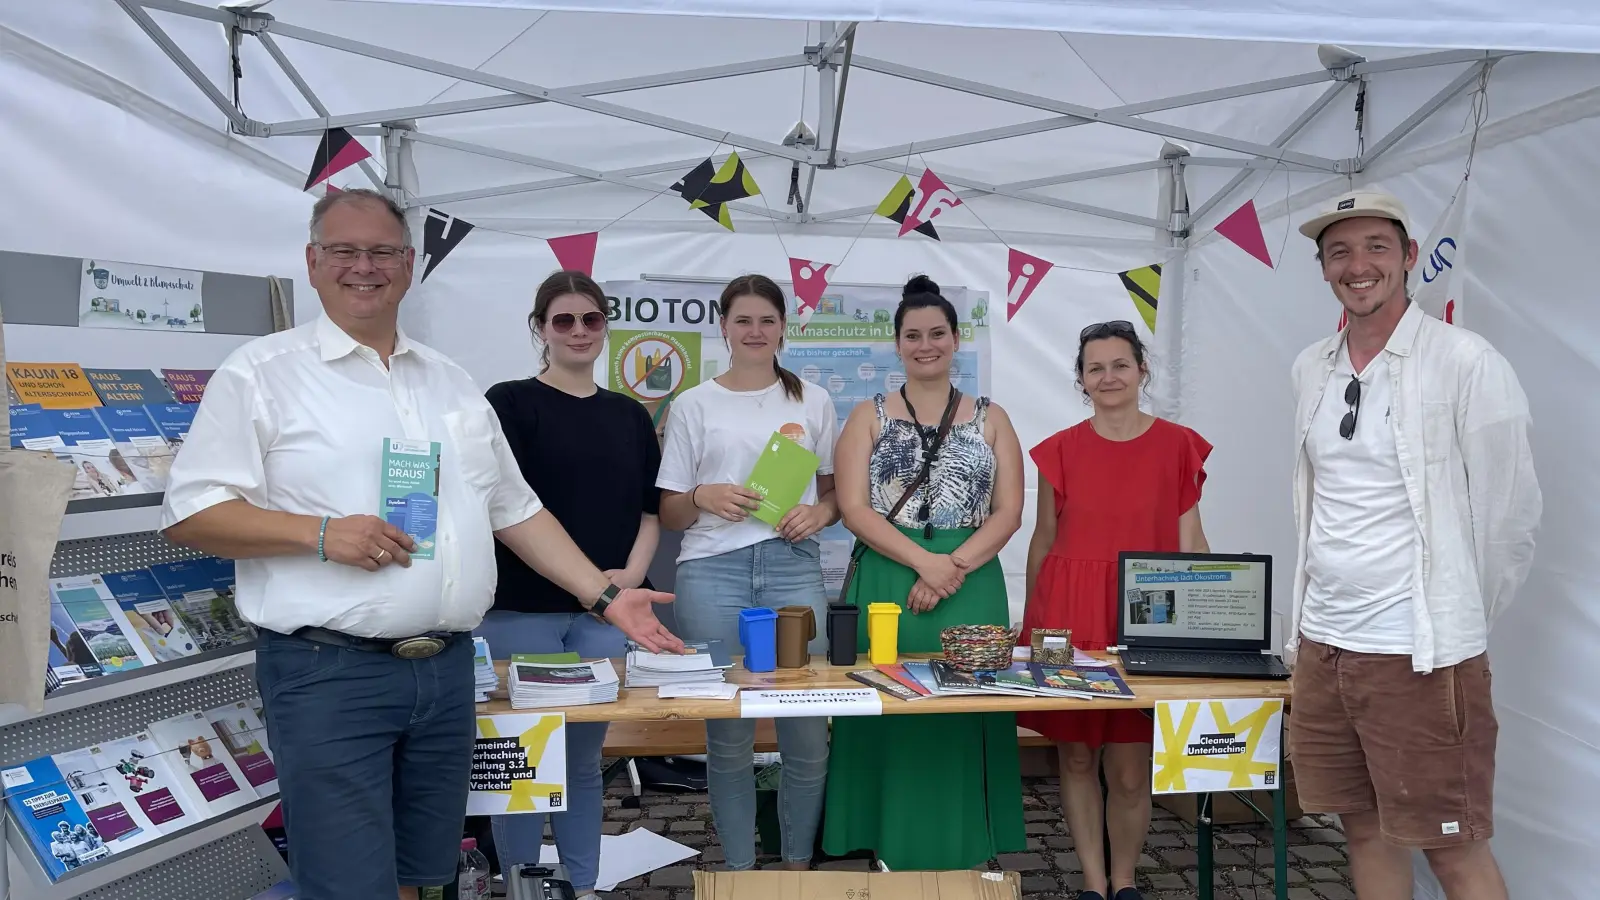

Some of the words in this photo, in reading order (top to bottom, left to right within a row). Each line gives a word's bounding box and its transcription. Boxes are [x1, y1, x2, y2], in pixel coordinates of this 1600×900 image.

[111, 274, 142, 287] Umwelt
[150, 276, 194, 290] Klimaschutz
[869, 325, 882, 337] in
[11, 368, 60, 380] KAUM
[61, 368, 79, 380] 18
[89, 372, 121, 381] RAUS
[167, 373, 196, 382] RAUS
[96, 383, 119, 391] MIT
[120, 383, 144, 391] DER
[174, 383, 193, 391] MIT
[106, 392, 144, 400] ALTEN!
[388, 459, 411, 468] MACH
[412, 461, 430, 470] WAS
[388, 468, 425, 479] DRAUS!
[750, 480, 769, 496] KLIMA
[1136, 573, 1179, 582] Unterhaching
[1200, 737, 1235, 745] Cleanup
[1188, 746, 1246, 755] Unterhaching
[473, 751, 525, 760] erhaching
[472, 762, 505, 771] eilung
[508, 761, 525, 769] 3.2
[472, 772, 510, 780] aschutz
[513, 770, 533, 779] und
[470, 781, 512, 790] Verkehr
[32, 795, 44, 804] TIPPS
